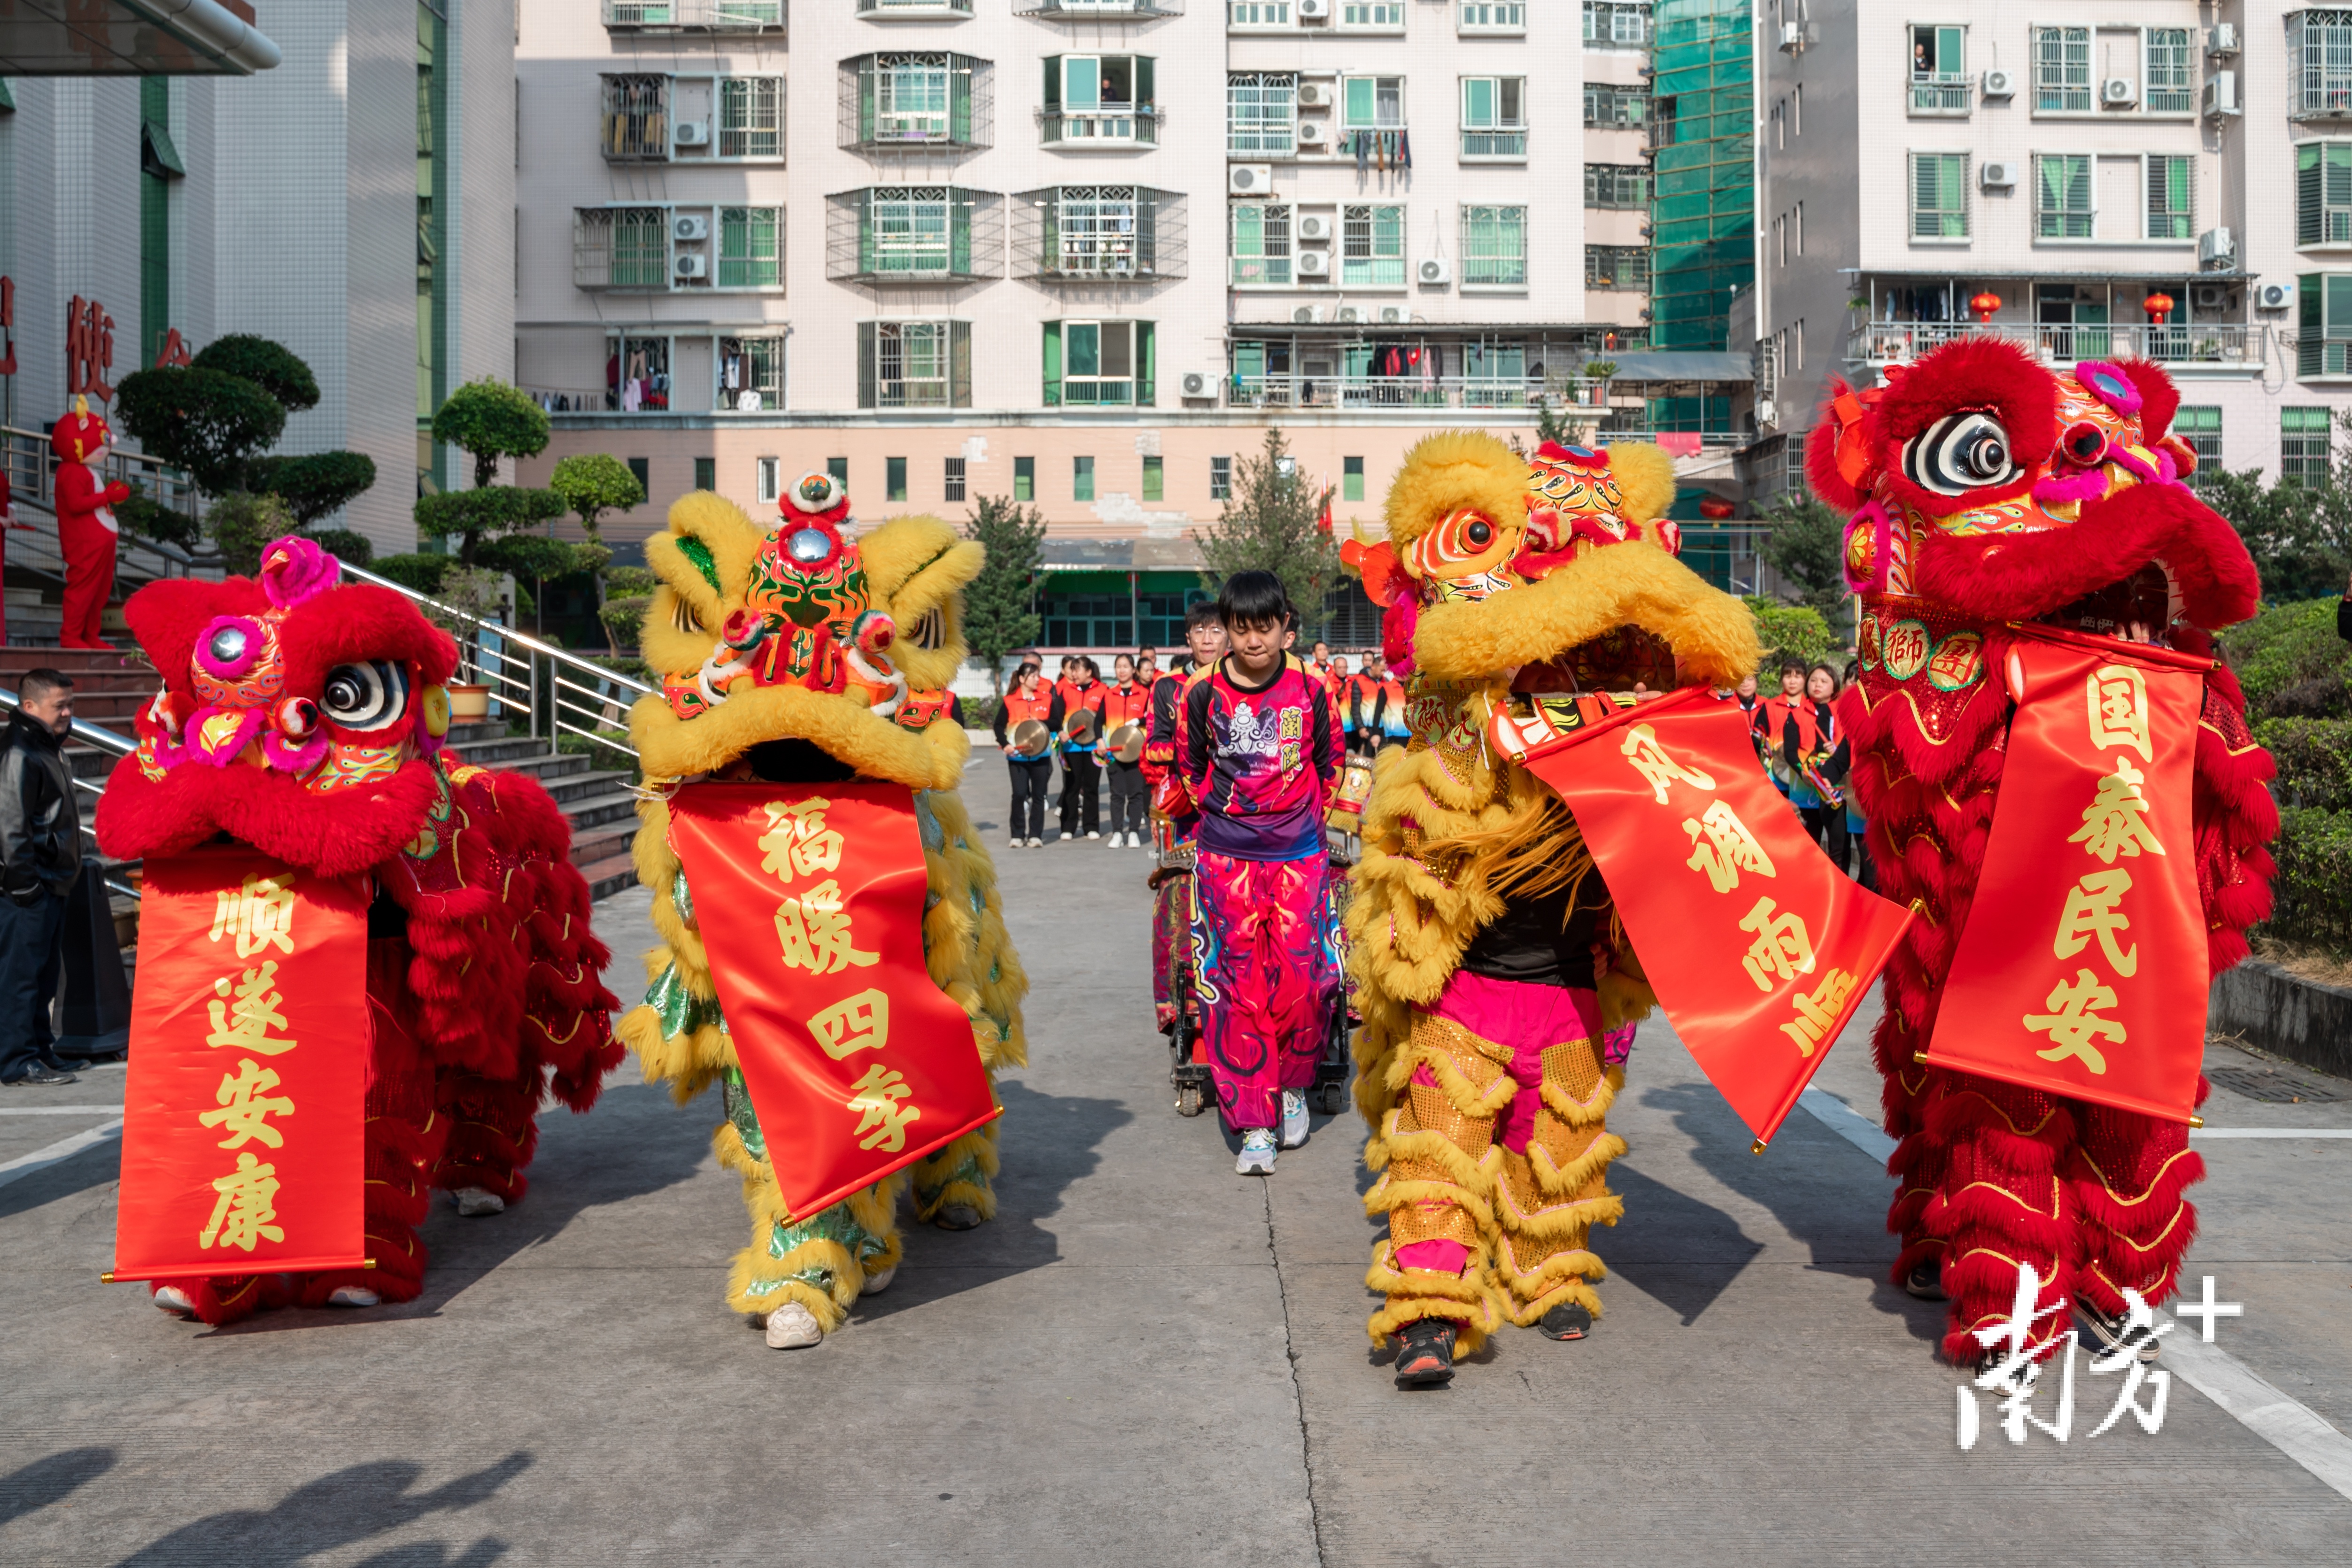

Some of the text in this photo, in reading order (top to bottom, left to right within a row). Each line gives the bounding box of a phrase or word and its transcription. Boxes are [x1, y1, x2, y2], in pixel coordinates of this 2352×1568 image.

[758, 796, 921, 1152] 福暖四季
[1620, 723, 1858, 1058] 风调雨顺
[2023, 665, 2166, 1074] 国泰民安
[199, 872, 297, 1251] 顺遂安康
